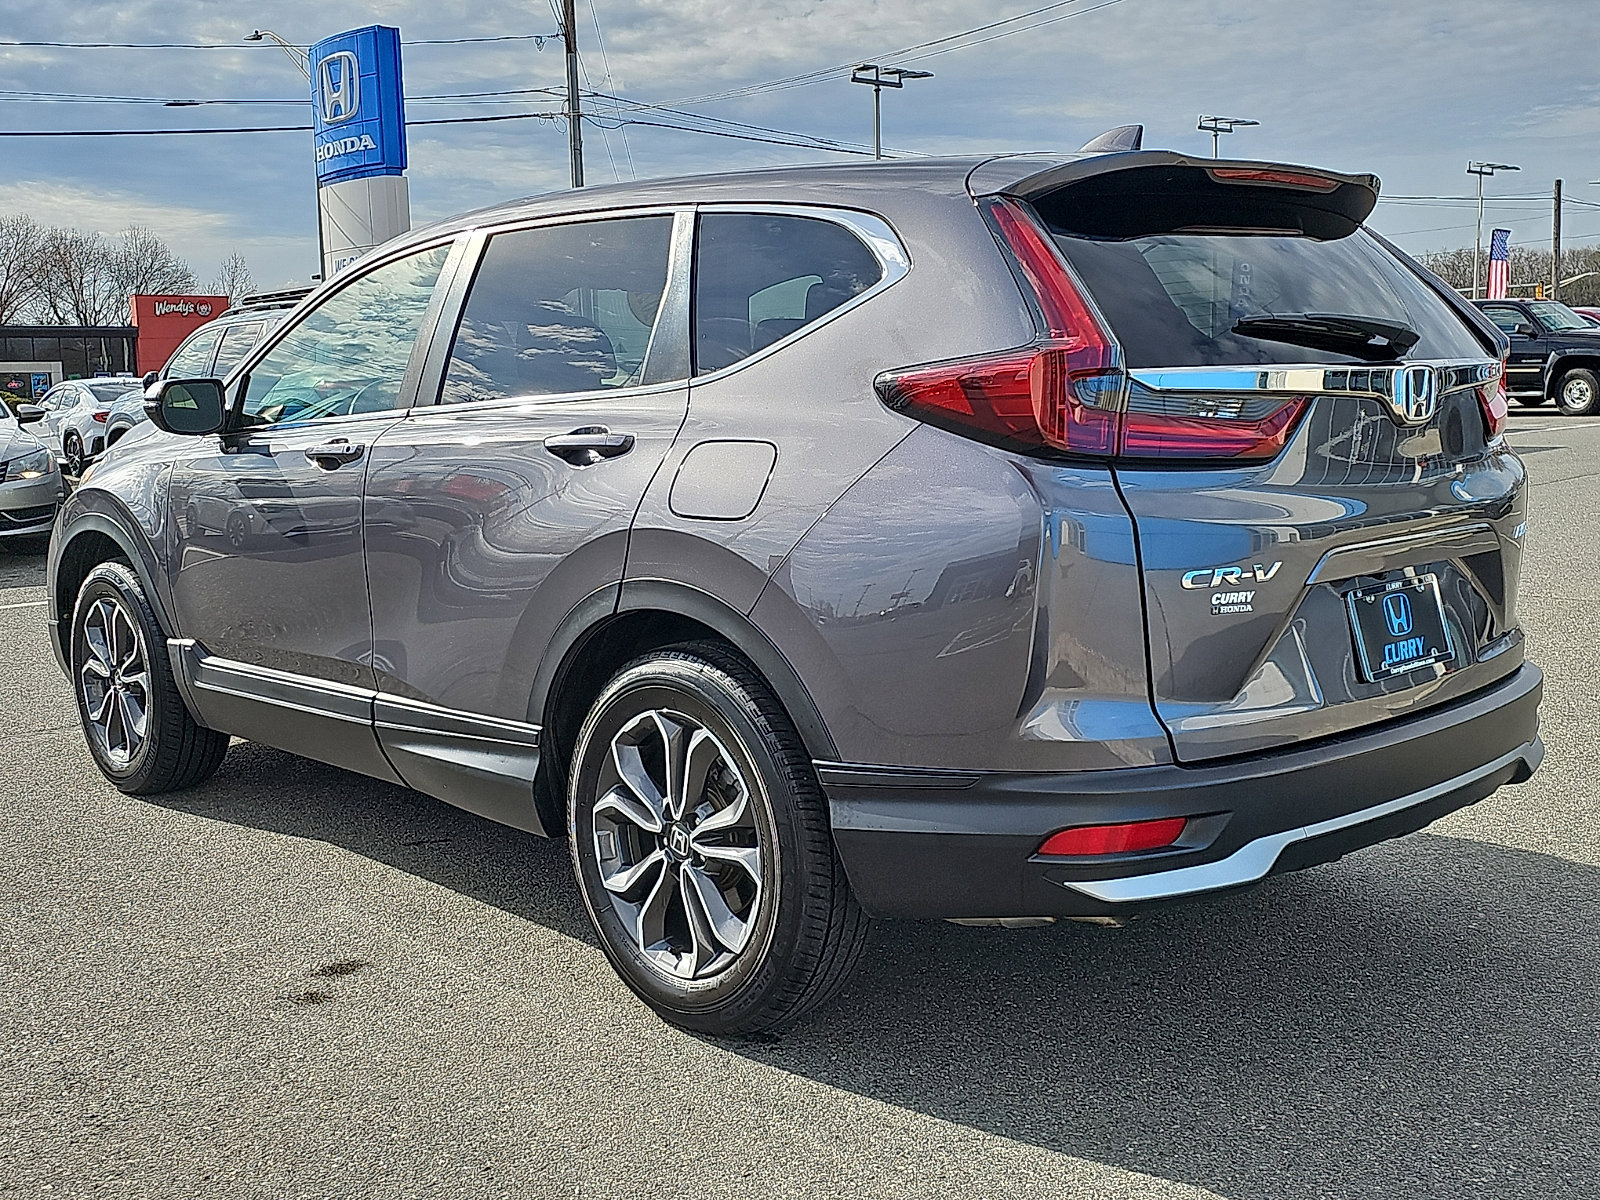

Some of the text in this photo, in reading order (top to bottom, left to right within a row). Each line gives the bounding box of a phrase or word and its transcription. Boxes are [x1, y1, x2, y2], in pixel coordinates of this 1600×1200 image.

[316, 134, 377, 162] HONDA
[154, 299, 195, 316] Wendy's
[1181, 561, 1283, 589] CR-V
[1211, 590, 1256, 605] CURRY
[1220, 604, 1253, 614] HONDA
[1385, 636, 1424, 665] CURRY
